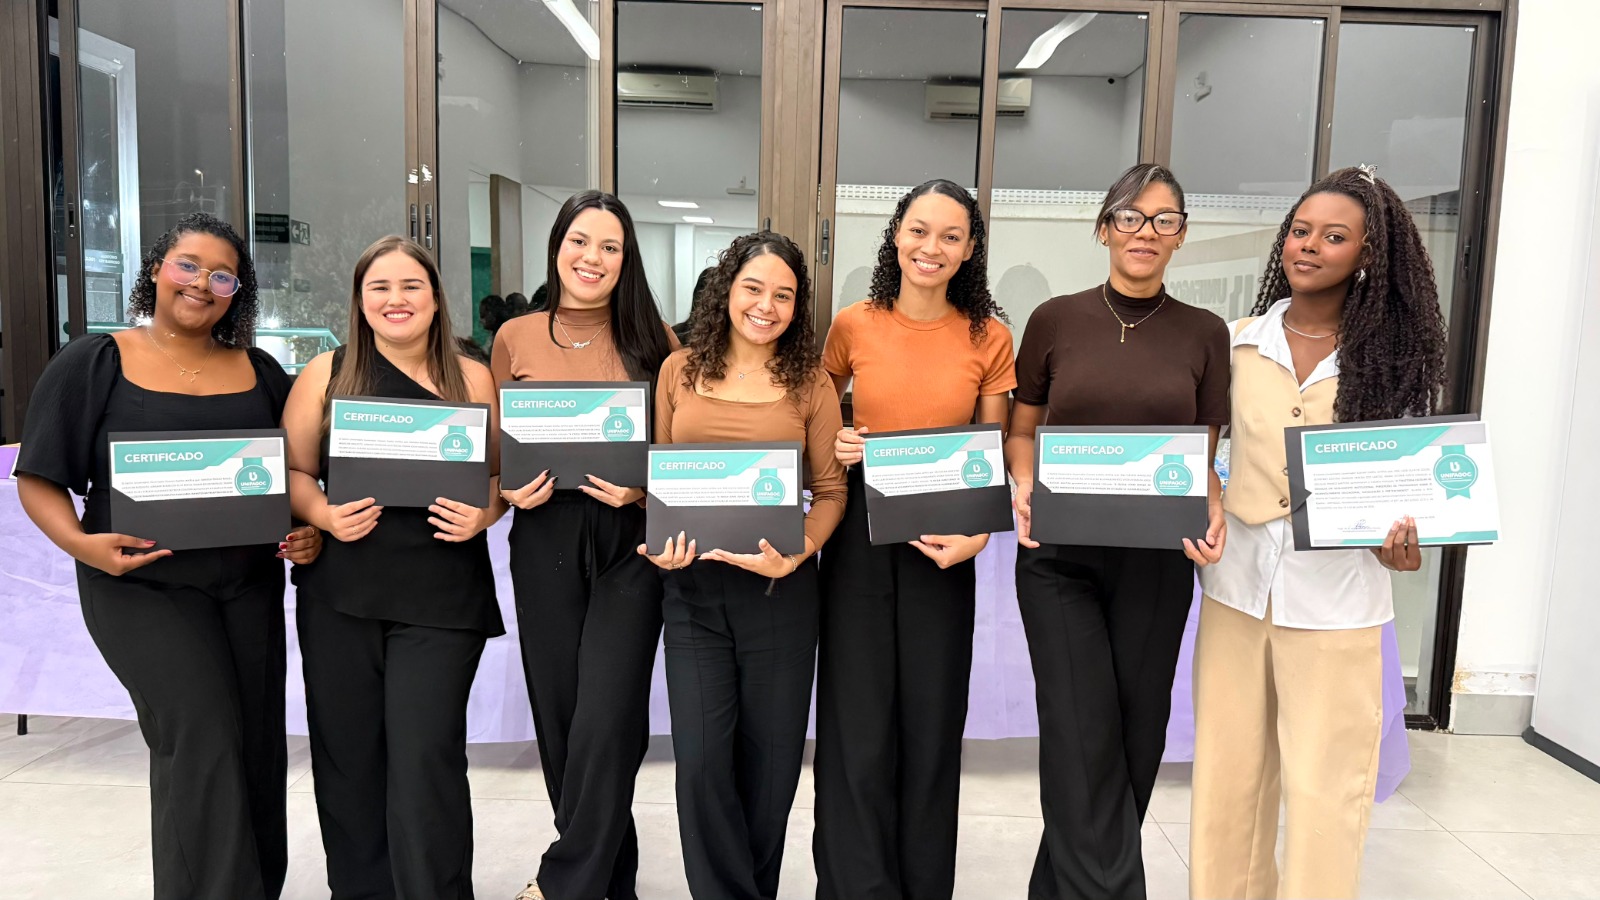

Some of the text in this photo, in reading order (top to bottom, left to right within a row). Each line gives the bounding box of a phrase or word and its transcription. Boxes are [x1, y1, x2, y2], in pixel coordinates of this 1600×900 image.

[511, 400, 577, 409] CERTIFICADO
[343, 412, 414, 424] CERTIFICADO
[873, 445, 936, 458] CERTIFICADO
[1051, 445, 1125, 455] CERTIFICADO
[1315, 439, 1398, 454] CERTIFICADO
[124, 451, 204, 464] CERTIFICADO
[658, 461, 726, 471] CERTIFICADO
